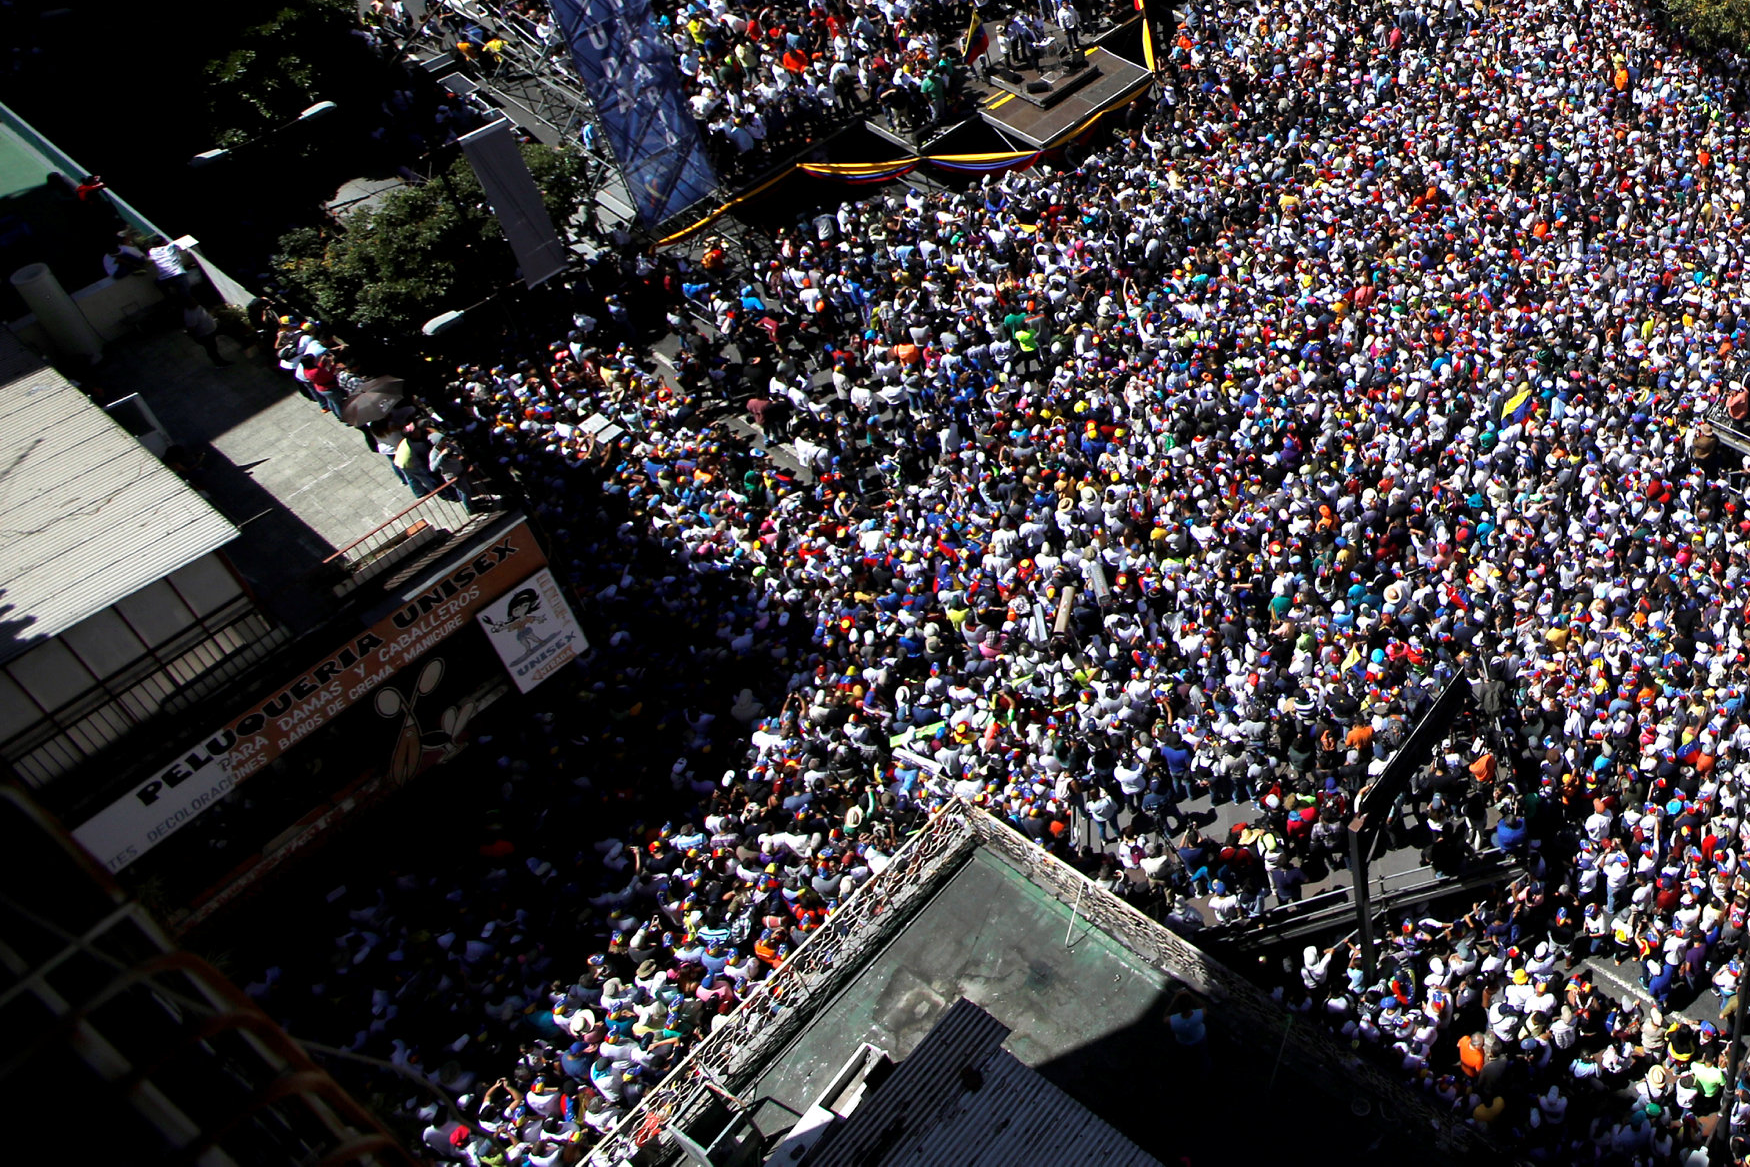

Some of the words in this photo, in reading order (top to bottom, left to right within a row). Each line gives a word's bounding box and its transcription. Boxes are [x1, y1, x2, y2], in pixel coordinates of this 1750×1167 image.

[136, 632, 382, 806] PELUQUERIA
[391, 536, 520, 631] UNISEX
[147, 753, 267, 843] DECOLORACIONES
[328, 698, 346, 720] DE
[348, 664, 394, 707] CREMA
[401, 613, 464, 660] MANICURE
[217, 735, 270, 775] PARA
[277, 679, 344, 732] DAMAS
[354, 662, 367, 680] Y
[378, 586, 480, 664] CABALLEROS
[516, 631, 577, 677] UNISEX
